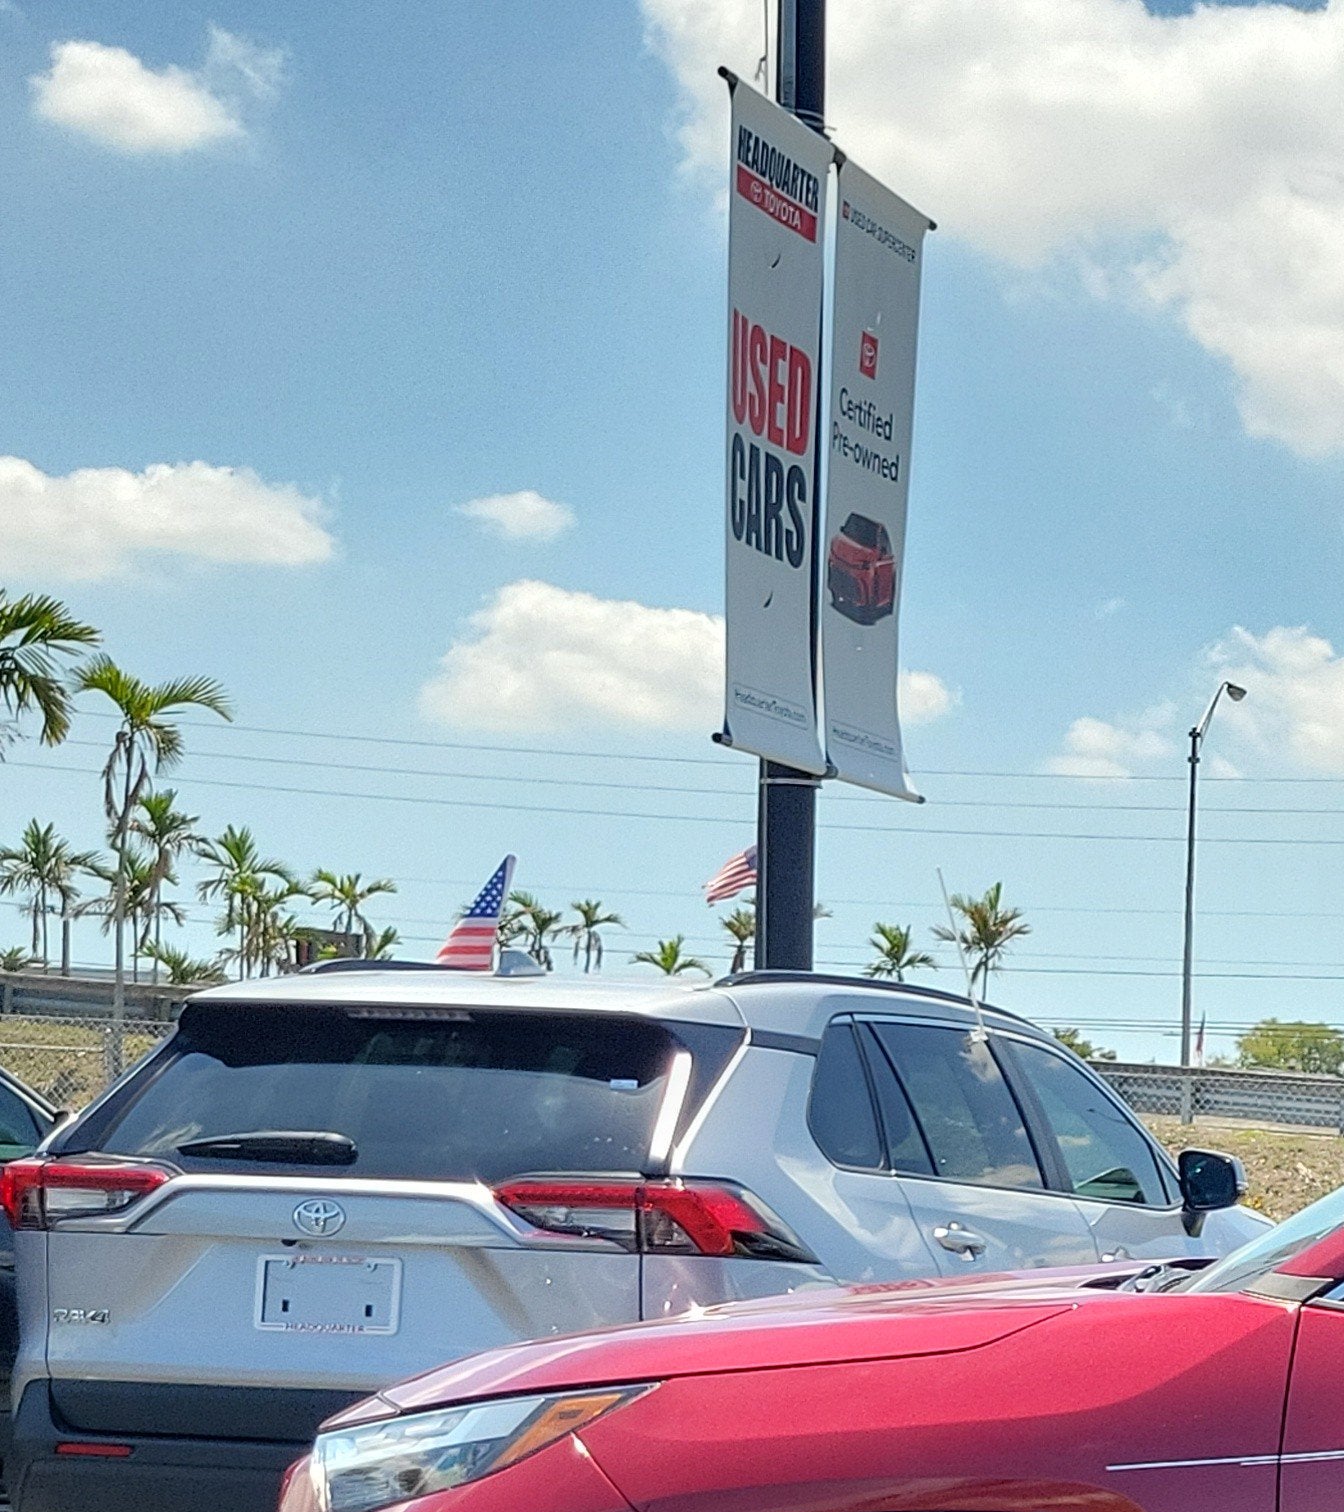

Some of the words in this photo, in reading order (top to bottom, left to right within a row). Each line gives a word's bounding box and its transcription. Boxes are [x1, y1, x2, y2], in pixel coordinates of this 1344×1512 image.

[737, 124, 820, 214] HEADQUARTER
[763, 188, 801, 230] TOYOTA
[732, 307, 812, 456] USED
[840, 387, 893, 441] Certified
[833, 421, 899, 482] Pre-owned
[731, 432, 807, 568] CARS
